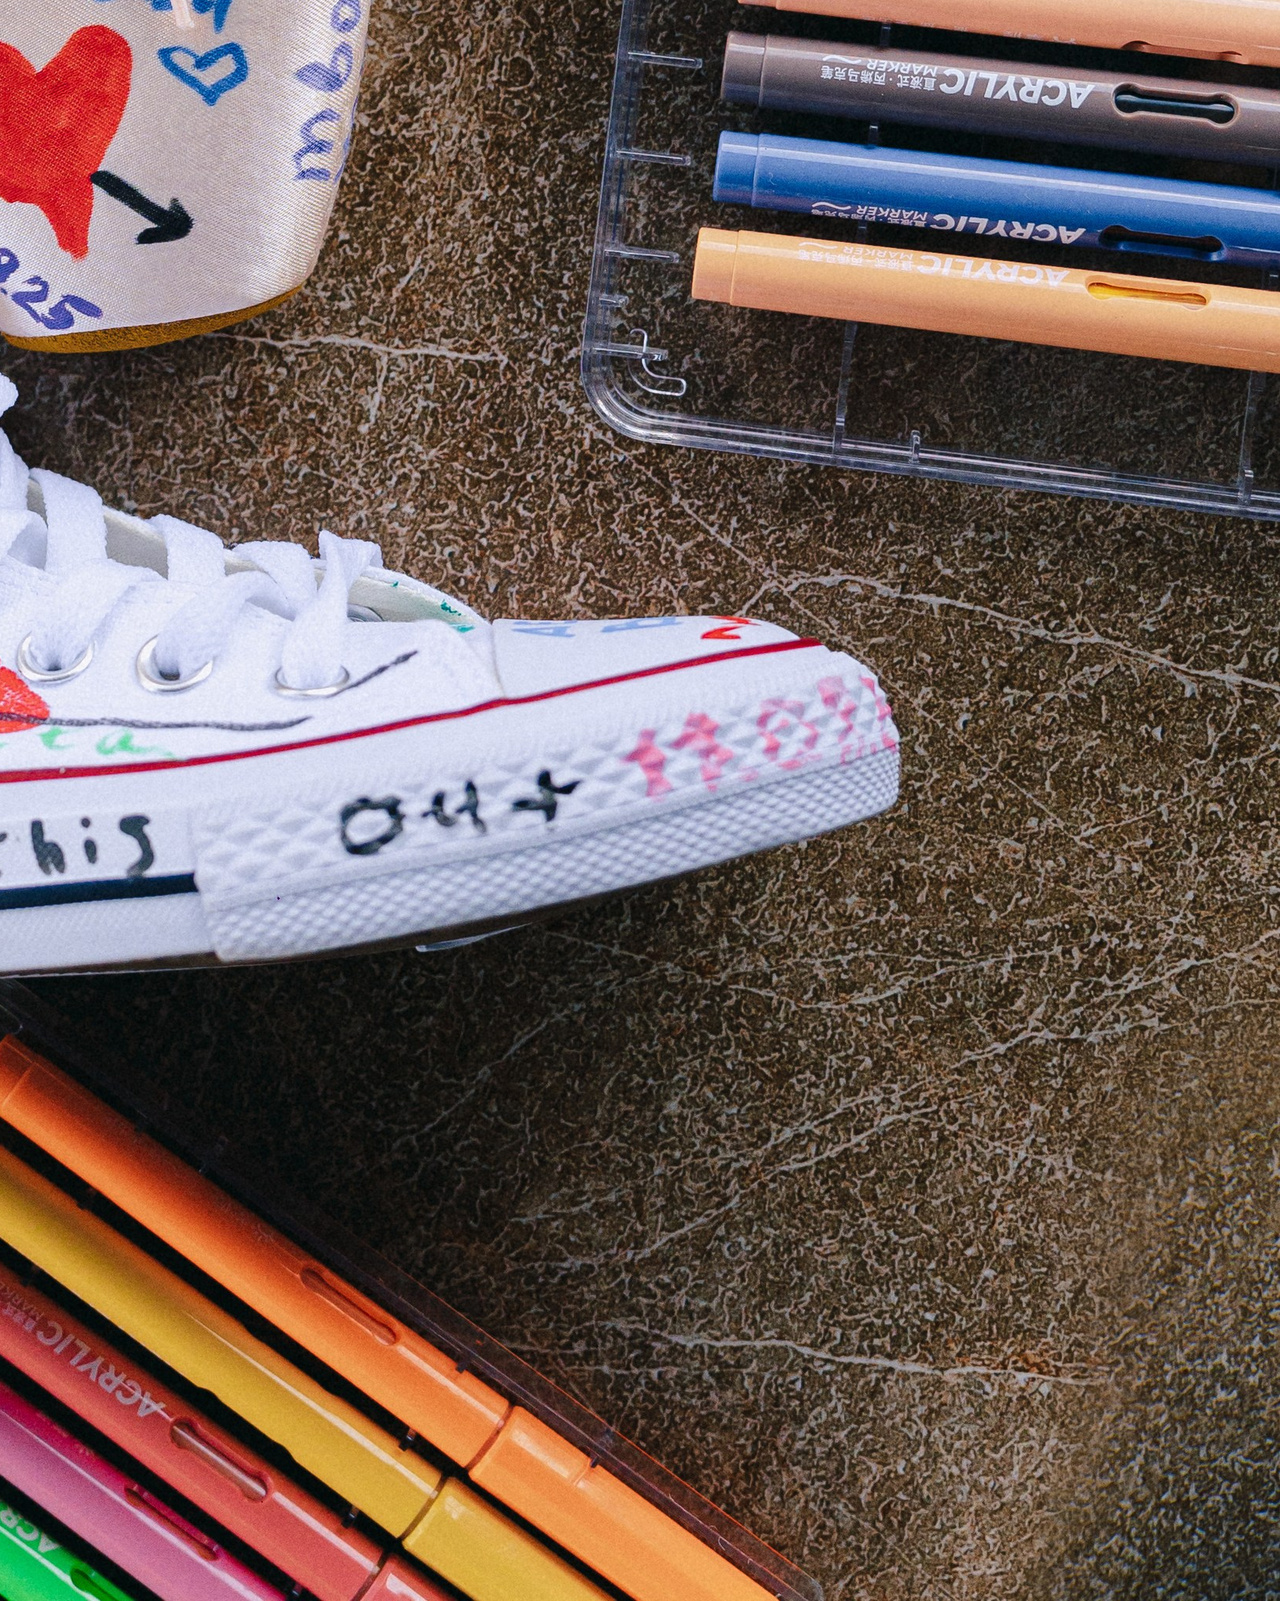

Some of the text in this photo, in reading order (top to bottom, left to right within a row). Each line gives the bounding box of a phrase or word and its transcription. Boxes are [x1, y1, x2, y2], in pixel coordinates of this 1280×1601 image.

[867, 58, 938, 77] MARKER
[940, 68, 1094, 108] ACRYLIC
[856, 204, 928, 222] MARKER
[932, 214, 1086, 244] ACRYLIC
[842, 242, 915, 260] MARKER
[918, 255, 1070, 286] ACRYLIC
[36, 1320, 167, 1418] ACRYLIC
